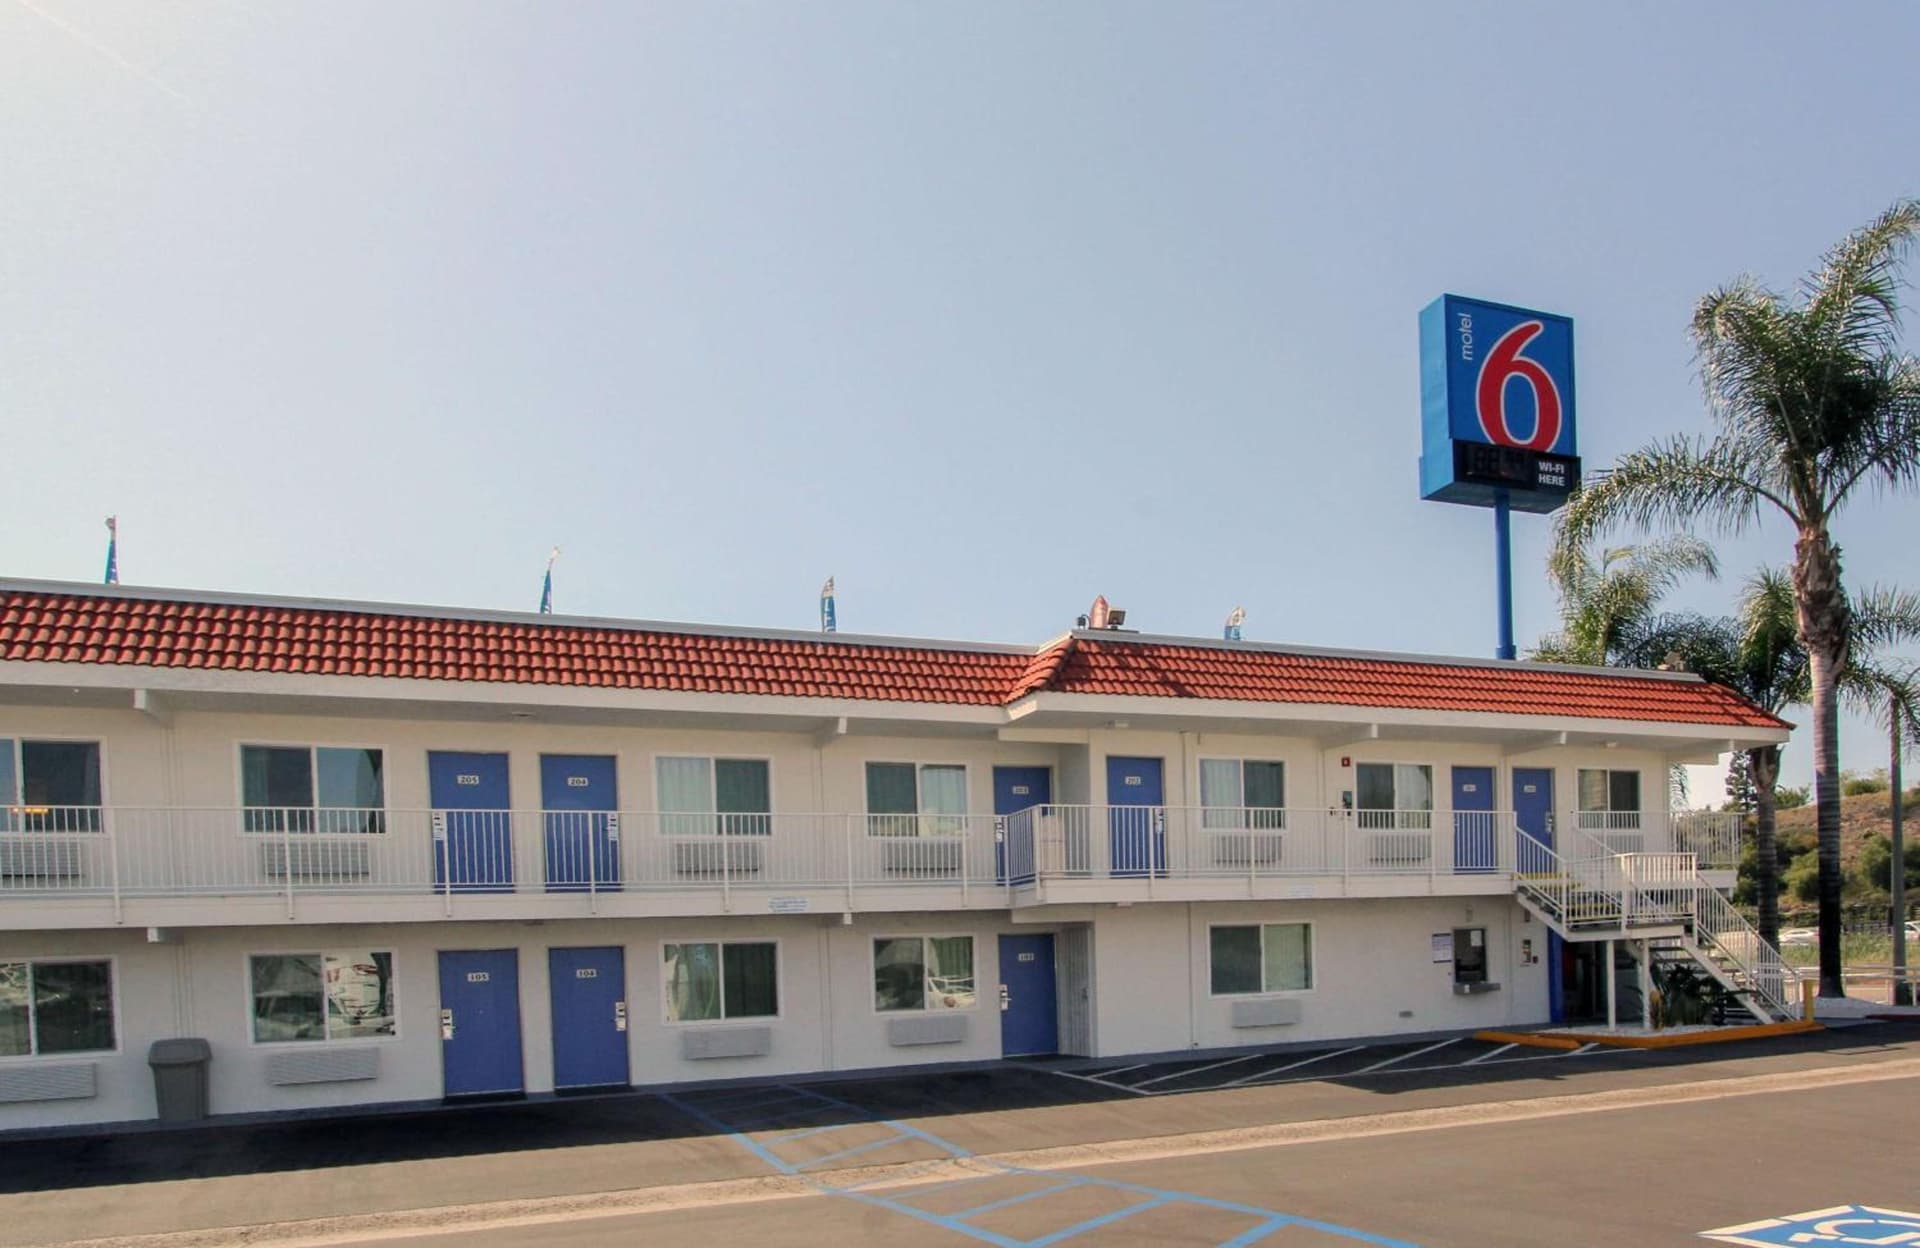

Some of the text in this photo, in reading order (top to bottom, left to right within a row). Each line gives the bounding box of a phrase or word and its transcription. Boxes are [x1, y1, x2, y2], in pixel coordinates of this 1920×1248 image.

[1458, 313, 1473, 361] motel
[1476, 320, 1562, 453] 6
[1538, 461, 1564, 473] WI-FI
[1538, 473, 1565, 487] HERE
[461, 776, 477, 784] 205
[570, 778, 586, 786] 204
[579, 969, 594, 977] 104
